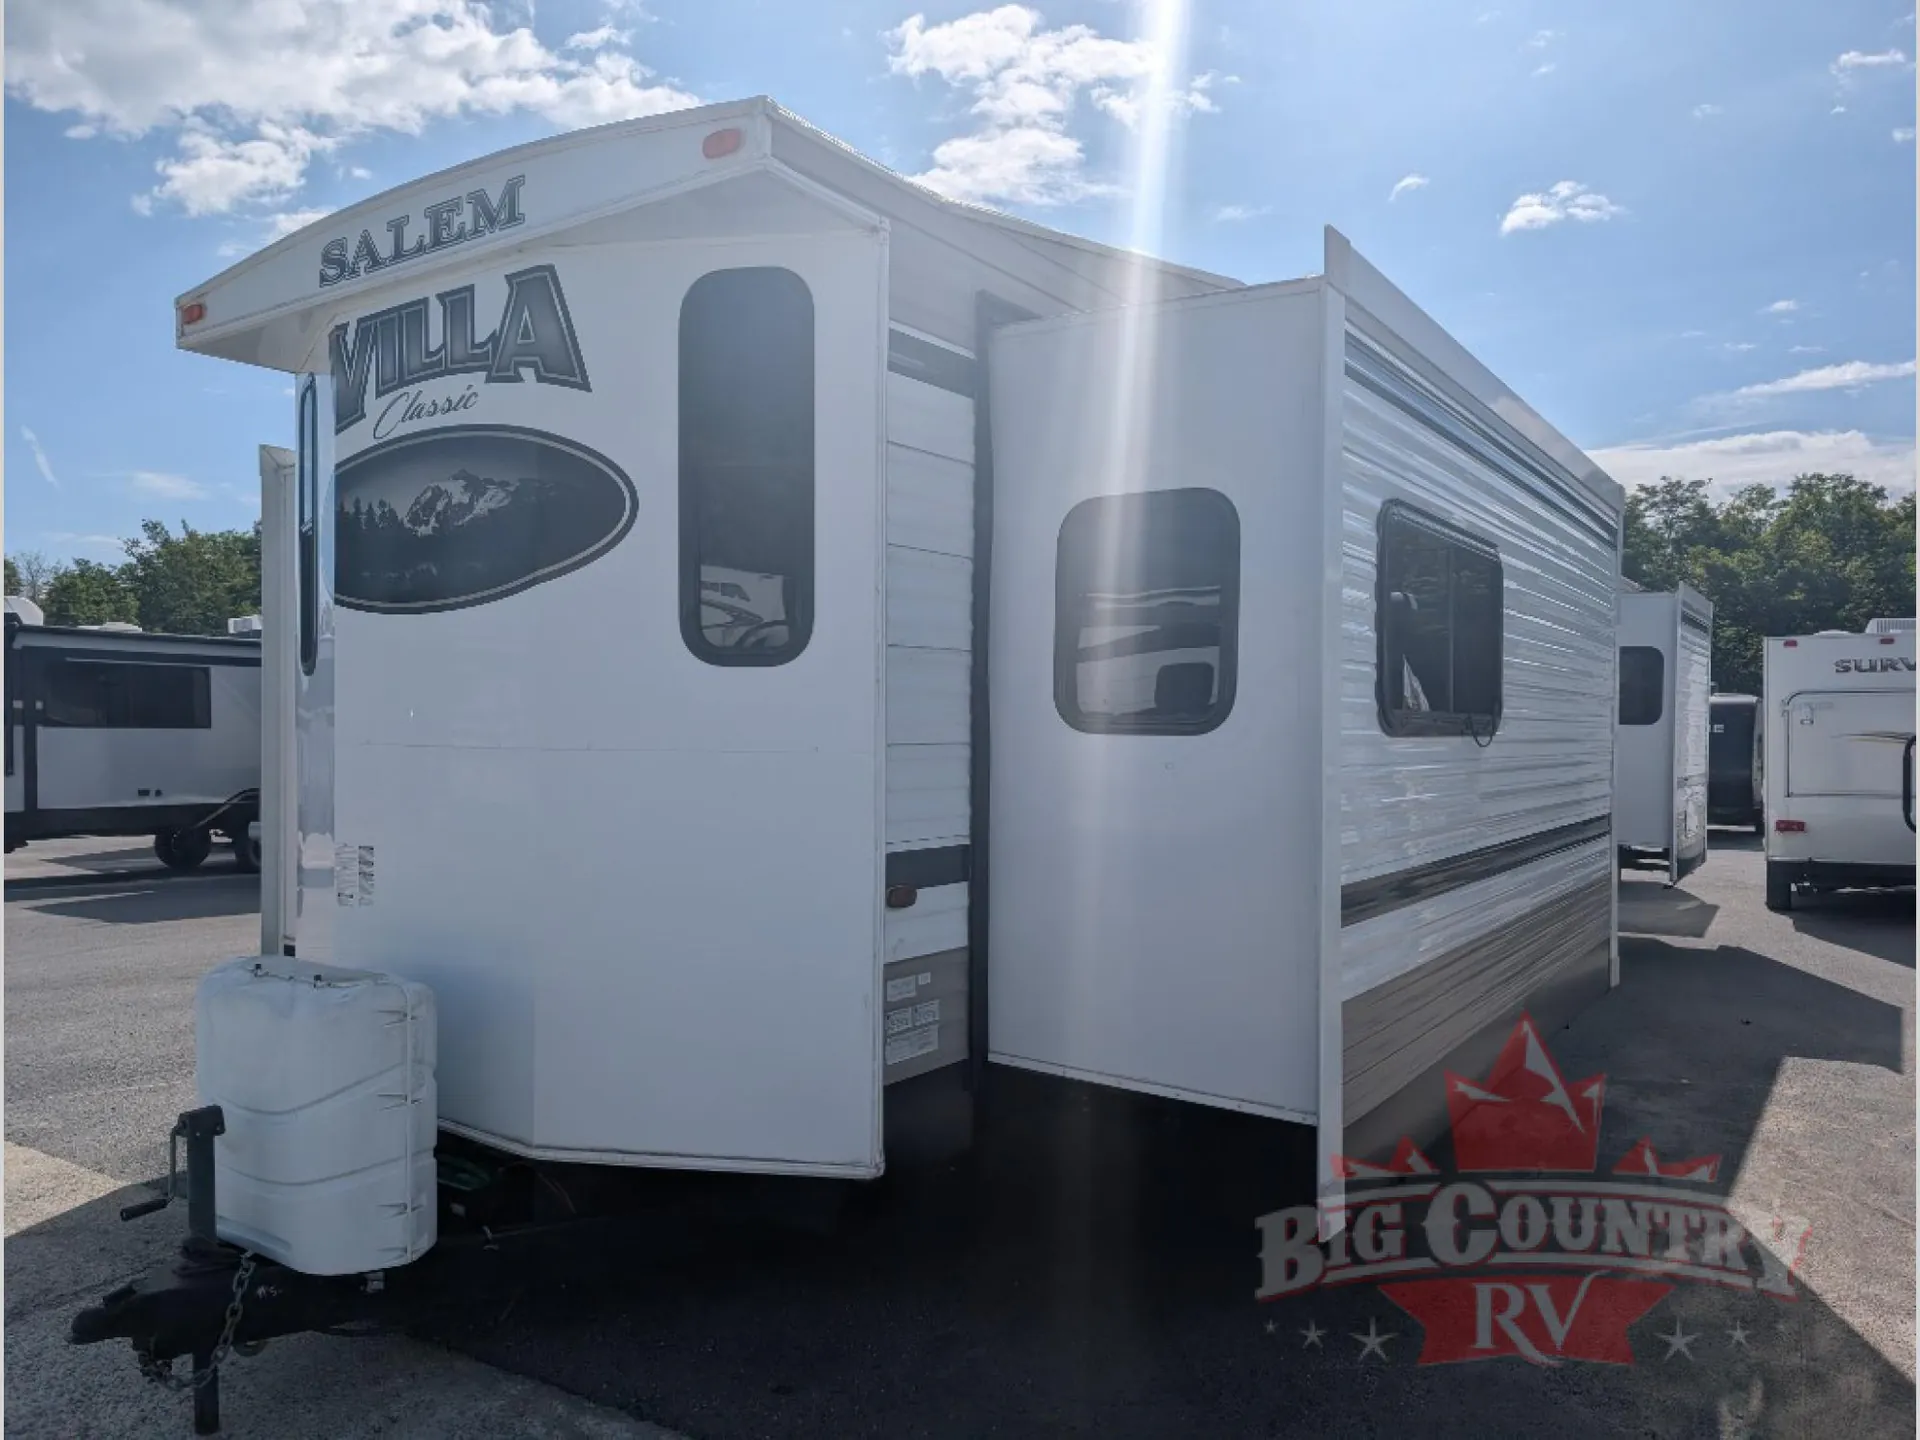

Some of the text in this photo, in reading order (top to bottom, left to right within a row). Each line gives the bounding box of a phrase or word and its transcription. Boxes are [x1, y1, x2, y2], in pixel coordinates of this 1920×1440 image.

[319, 174, 526, 288] SALEM
[328, 264, 593, 436] VILLA
[373, 384, 479, 440] Classic
